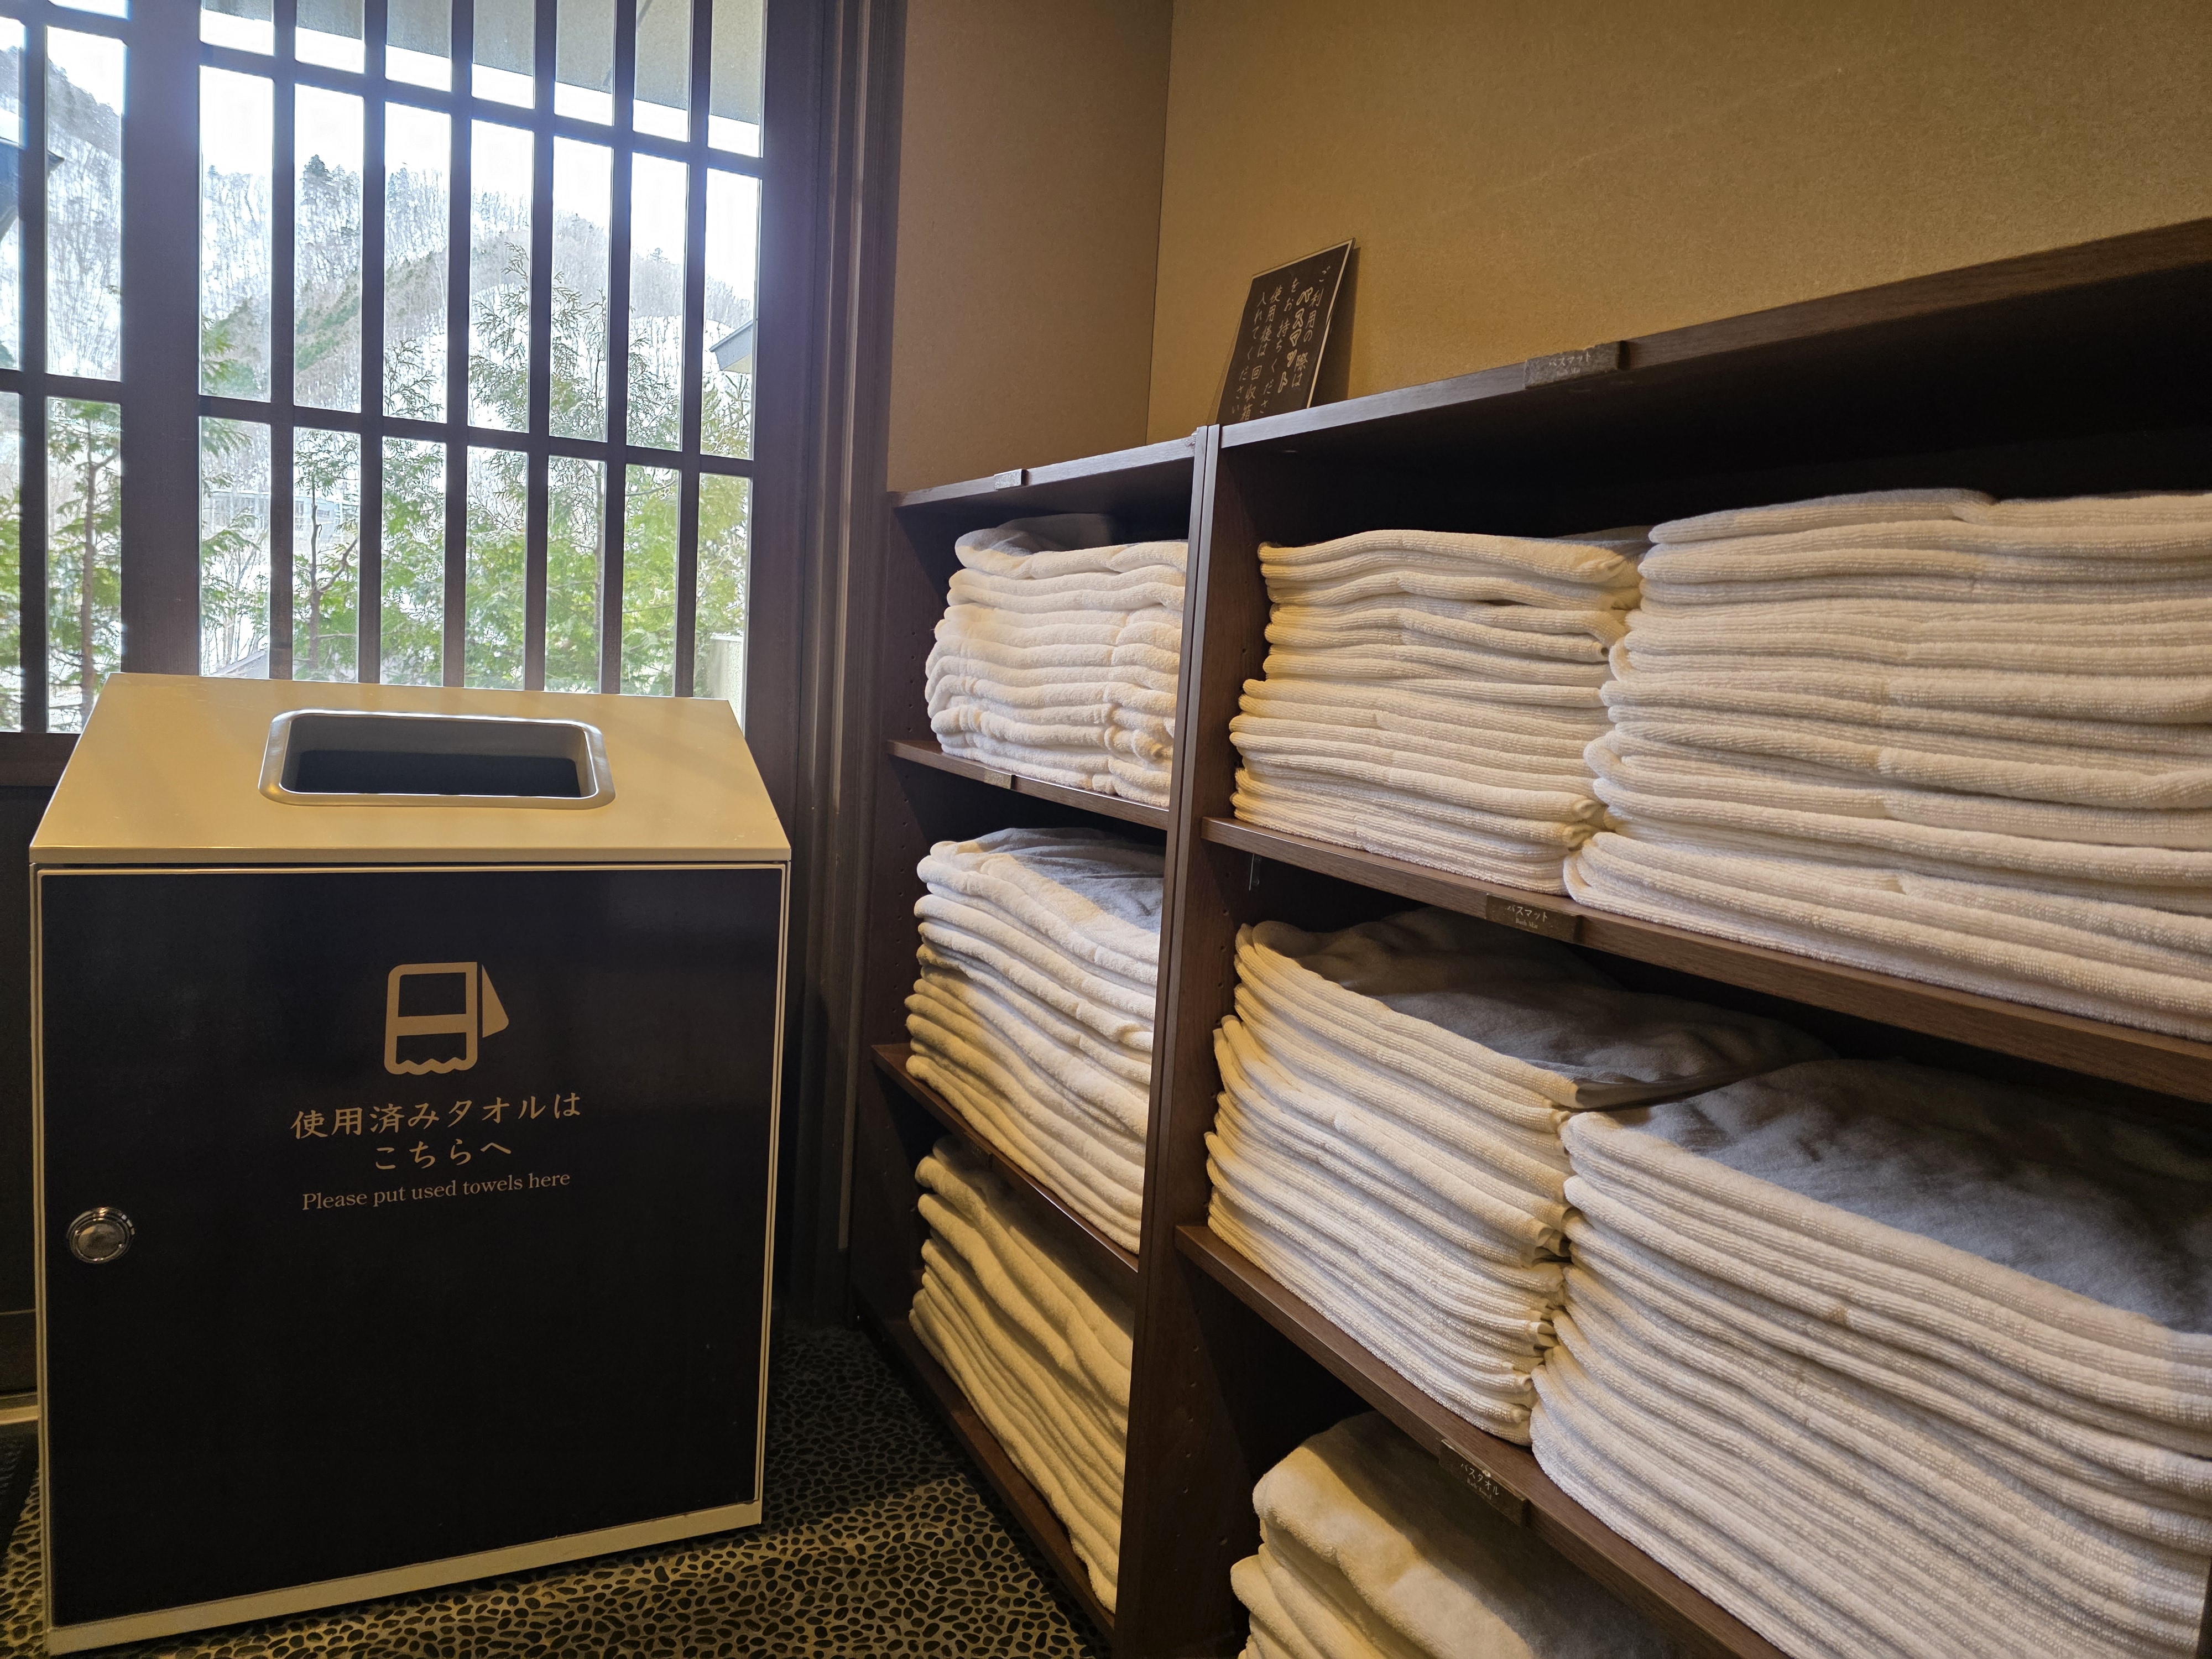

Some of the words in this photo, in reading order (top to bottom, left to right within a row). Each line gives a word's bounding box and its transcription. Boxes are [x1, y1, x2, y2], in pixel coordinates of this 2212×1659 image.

[1292, 265, 1331, 388] ご利用の際は
[1232, 291, 1266, 414] 入れてください
[1507, 905, 1548, 922] バスマット
[290, 1092, 581, 1140] 使用済みタオルは
[375, 1138, 512, 1170] こちらへ
[302, 1192, 368, 1211] Please
[373, 1187, 406, 1207] put
[411, 1180, 457, 1201] used
[463, 1175, 523, 1196] towels
[528, 1173, 570, 1189] here
